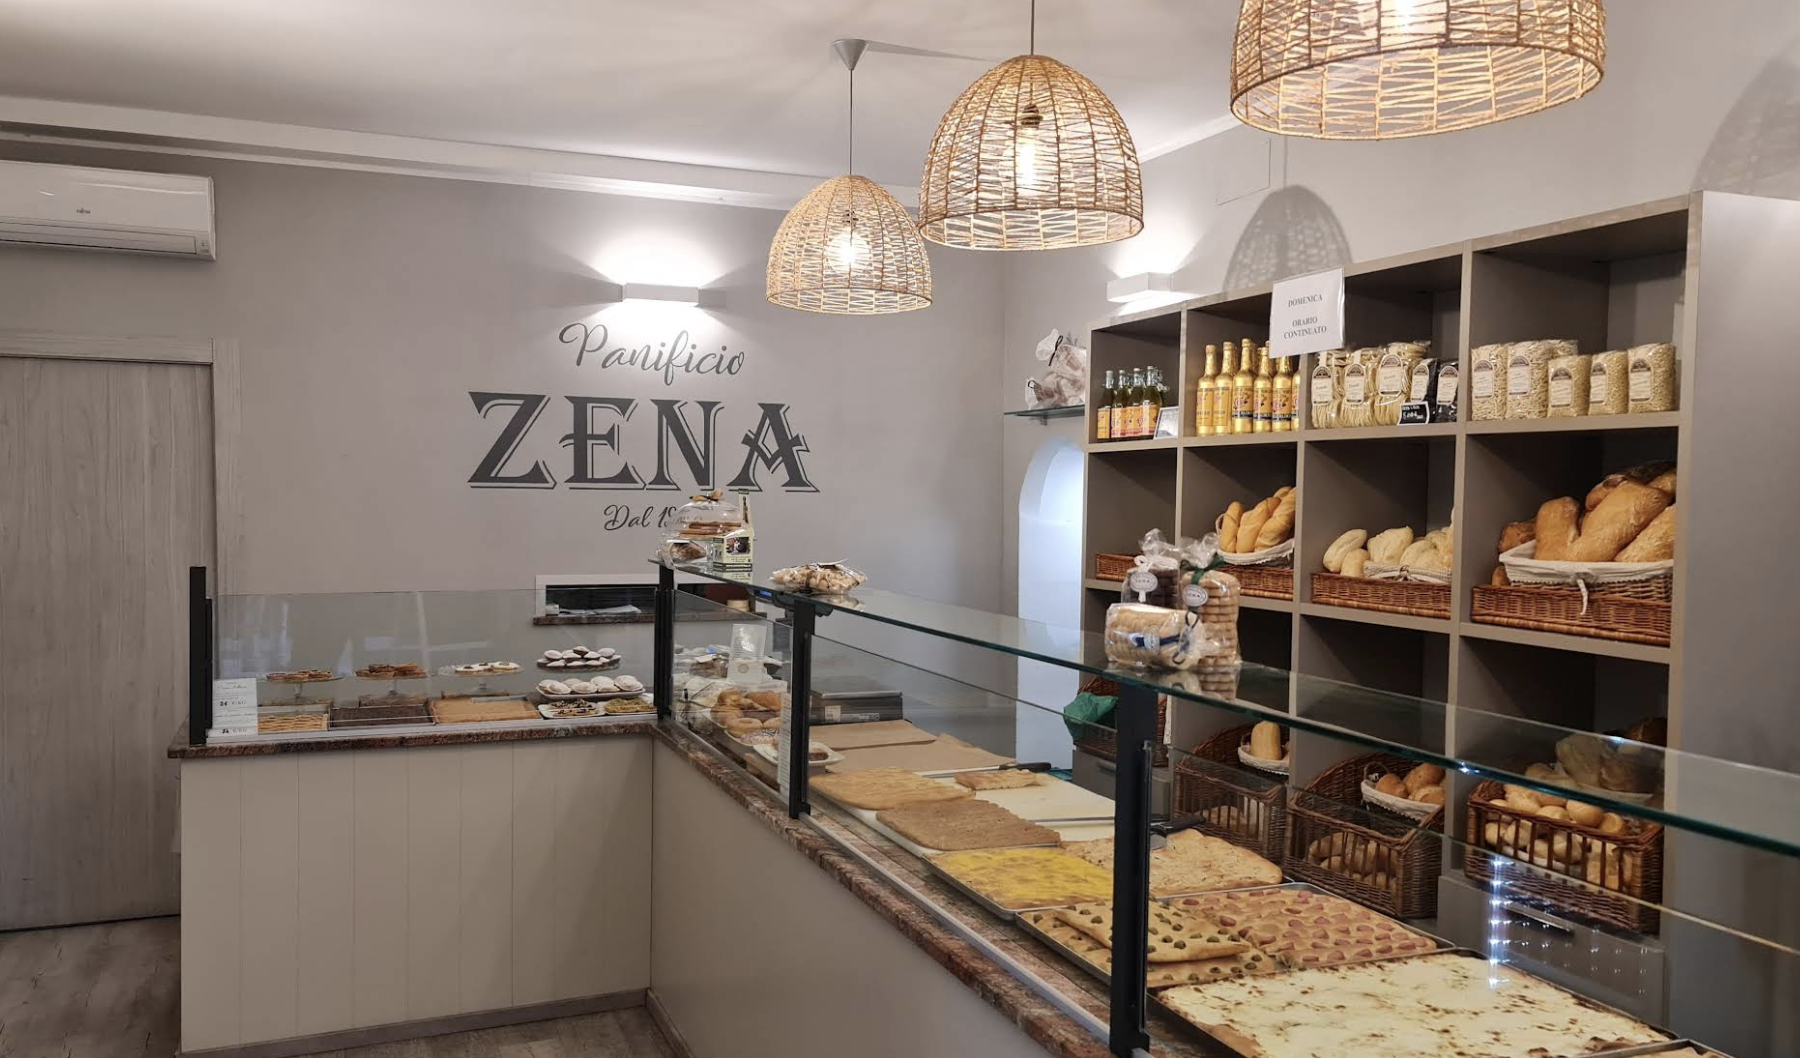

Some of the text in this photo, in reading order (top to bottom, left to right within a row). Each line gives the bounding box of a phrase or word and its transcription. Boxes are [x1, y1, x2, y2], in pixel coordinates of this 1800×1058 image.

[1288, 294, 1323, 307] DOMENICA
[1292, 316, 1318, 327] ORARIO
[1283, 326, 1327, 339] CONTINUATO
[558, 322, 745, 385] Panificio
[467, 391, 820, 493] ZENA
[603, 504, 653, 531] Dal
